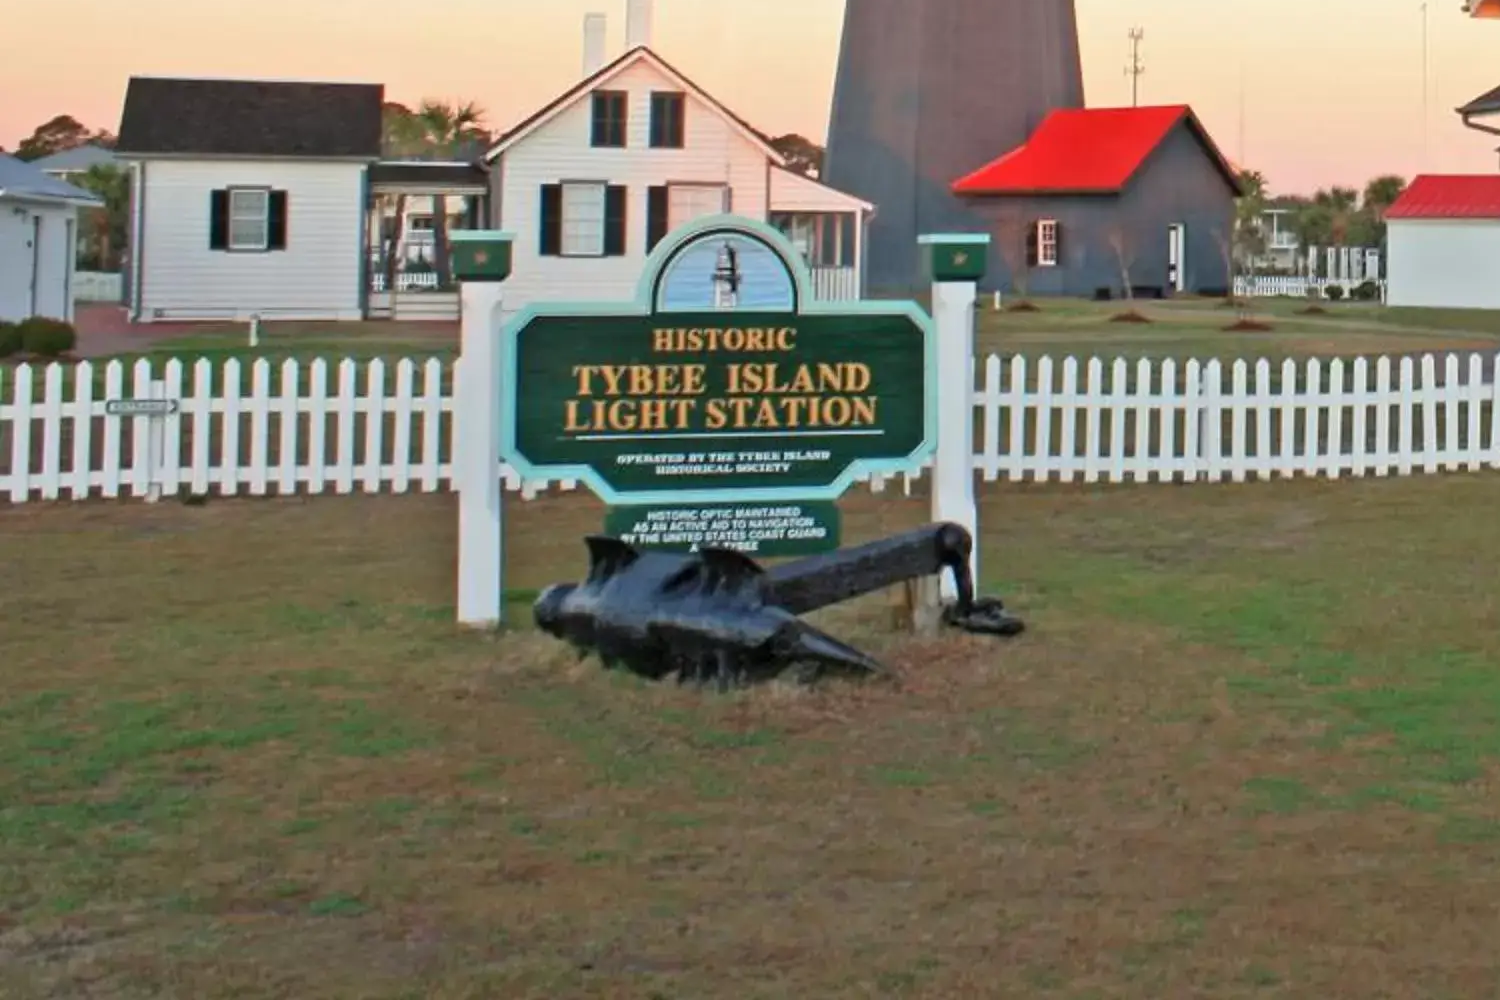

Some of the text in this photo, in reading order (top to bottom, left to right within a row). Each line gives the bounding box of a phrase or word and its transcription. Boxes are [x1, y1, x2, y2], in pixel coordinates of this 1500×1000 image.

[651, 326, 798, 351] HISTORIC
[572, 360, 871, 395] TYBEE ISLAND
[563, 395, 878, 431] LIGHT STATION
[617, 450, 831, 464] OPERATED BY THE TYBEE ISLAND
[655, 462, 791, 475] HISTORICAL SOCIETY
[647, 510, 699, 521] HISTORIC
[700, 509, 733, 520] OPTIC
[633, 517, 815, 533] AS AN ACTIVE AID TO NAVIGATION
[639, 533, 660, 544] THE
[662, 532, 703, 543] UNITED
[705, 530, 747, 542] STATES
[748, 529, 786, 540] COAST
[787, 527, 827, 539] GUARD
